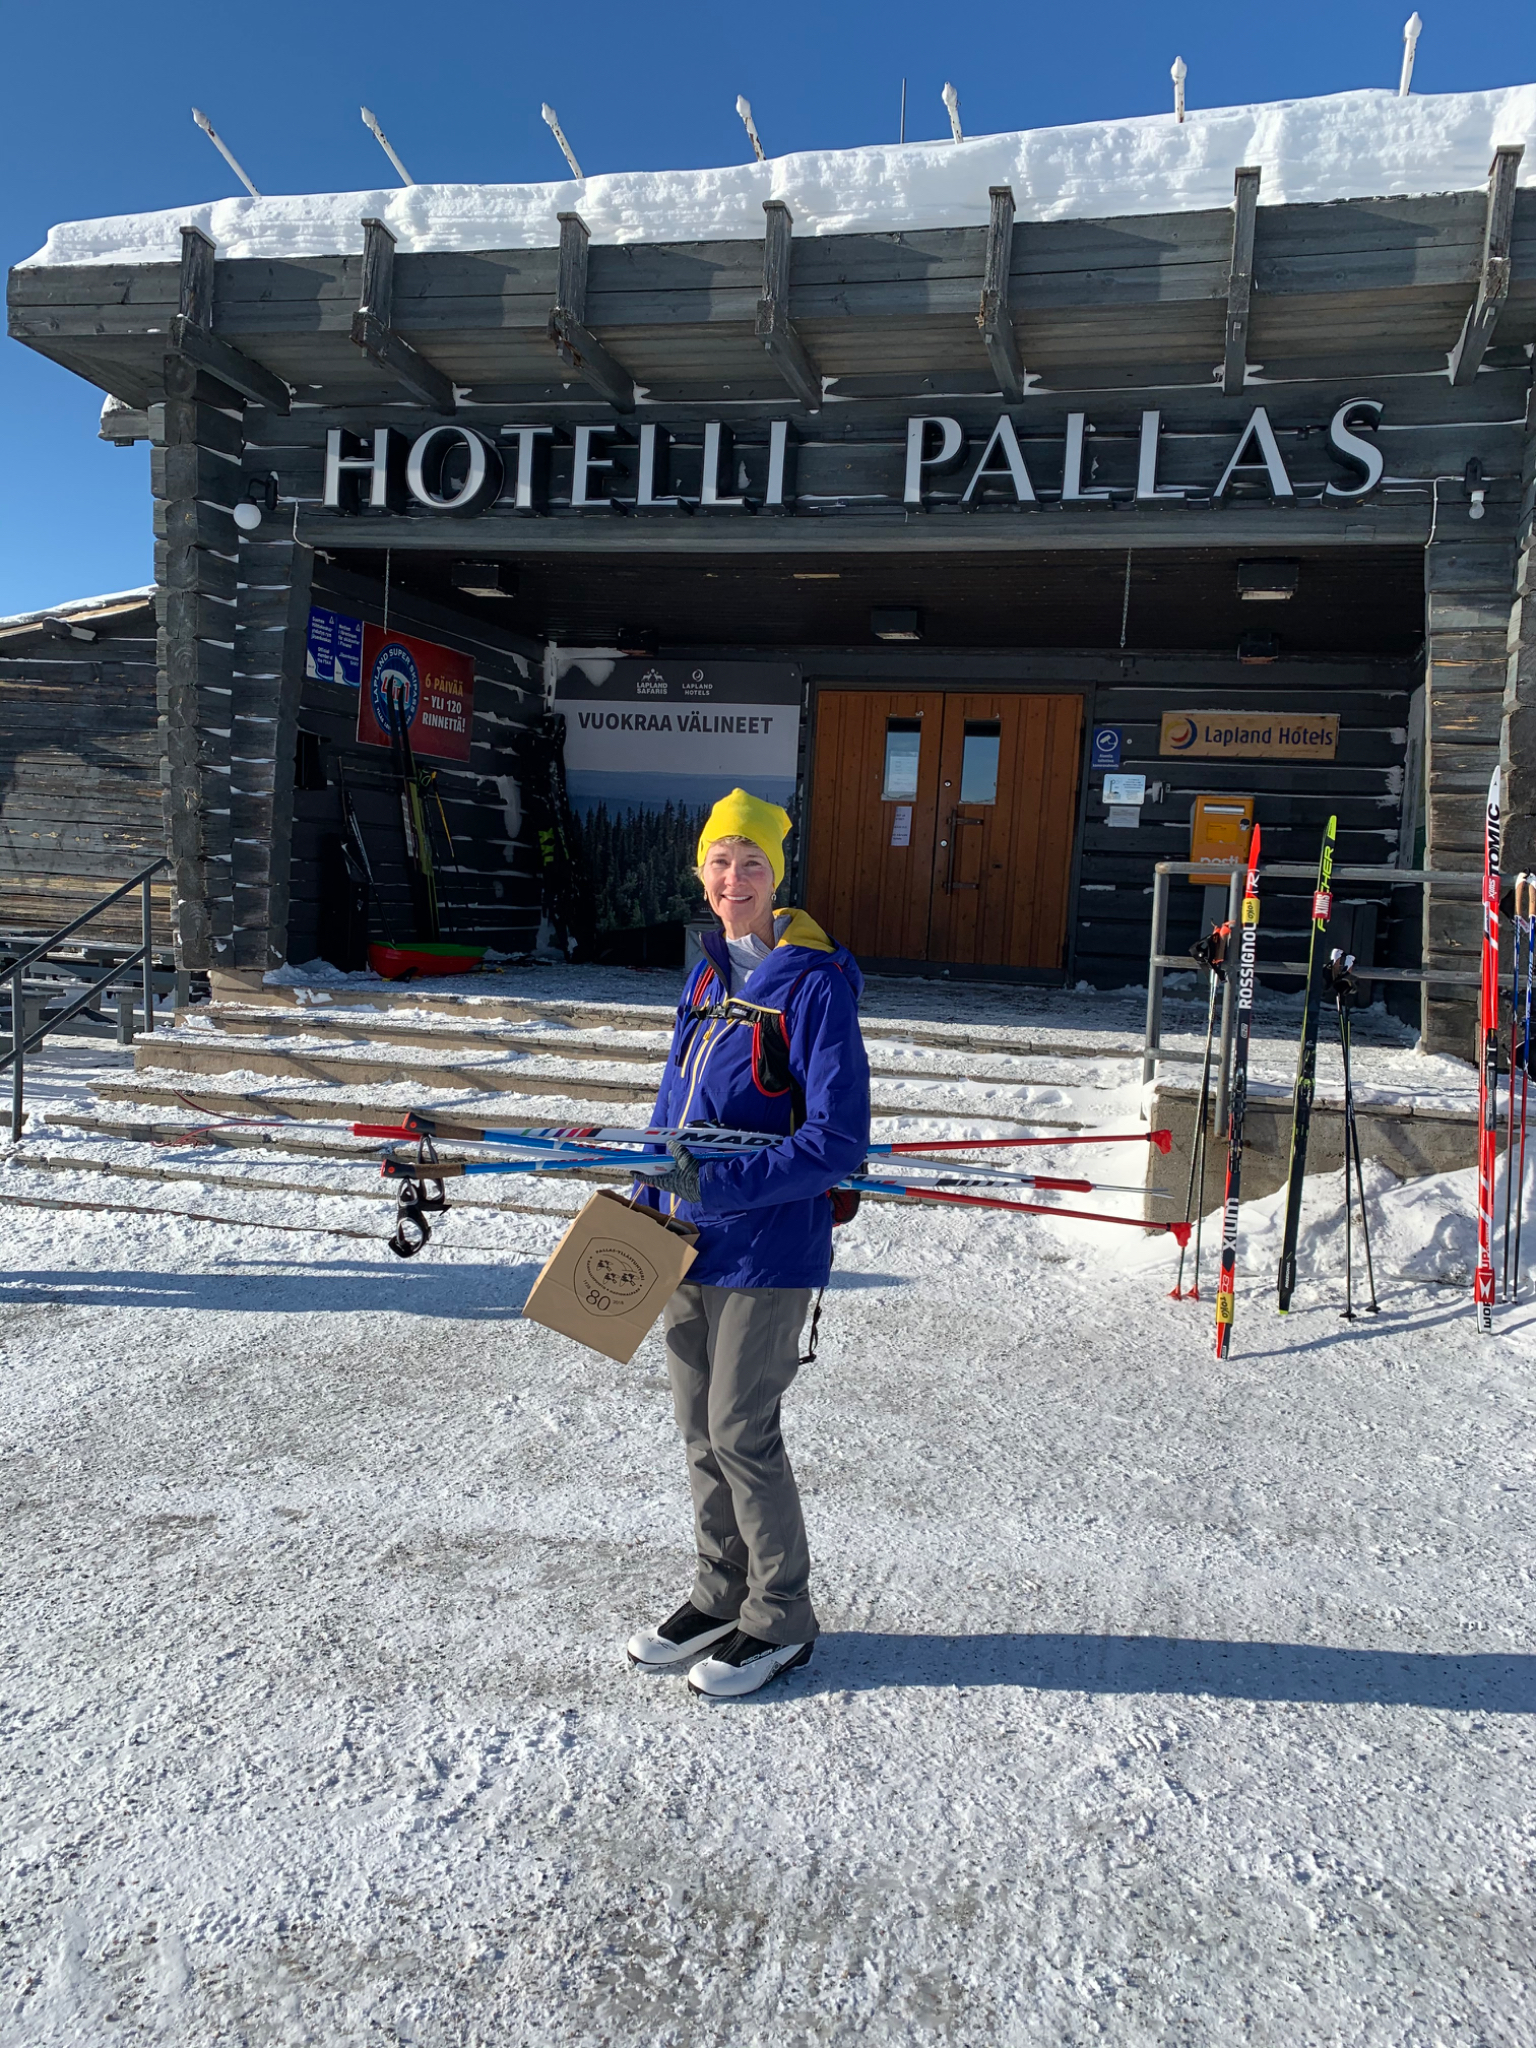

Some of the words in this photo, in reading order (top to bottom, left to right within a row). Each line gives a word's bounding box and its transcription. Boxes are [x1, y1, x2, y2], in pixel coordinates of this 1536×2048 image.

[322, 420, 790, 510] HOTELLI
[903, 397, 1385, 503] PALLAS
[373, 652, 389, 704] LAPLAND
[388, 647, 411, 665] SUPER
[408, 664, 418, 713] SKIPASS
[424, 672, 432, 689] 6
[433, 674, 464, 697] PÄIVÄÄ
[431, 695, 445, 710] YLI
[446, 699, 462, 714] 120
[421, 711, 466, 733] RINNETTÄ!
[578, 712, 672, 732] VUOKRAA
[677, 710, 773, 735] VÄLINEET
[1204, 726, 1271, 747] Lapland
[1278, 726, 1333, 746] Hotels
[1488, 803, 1500, 876] TOMIC
[1239, 923, 1257, 1009] ROSSIGNOL
[677, 1132, 783, 1146] MADS
[1482, 1252, 1490, 1269] UP
[585, 1289, 611, 1311] 80
